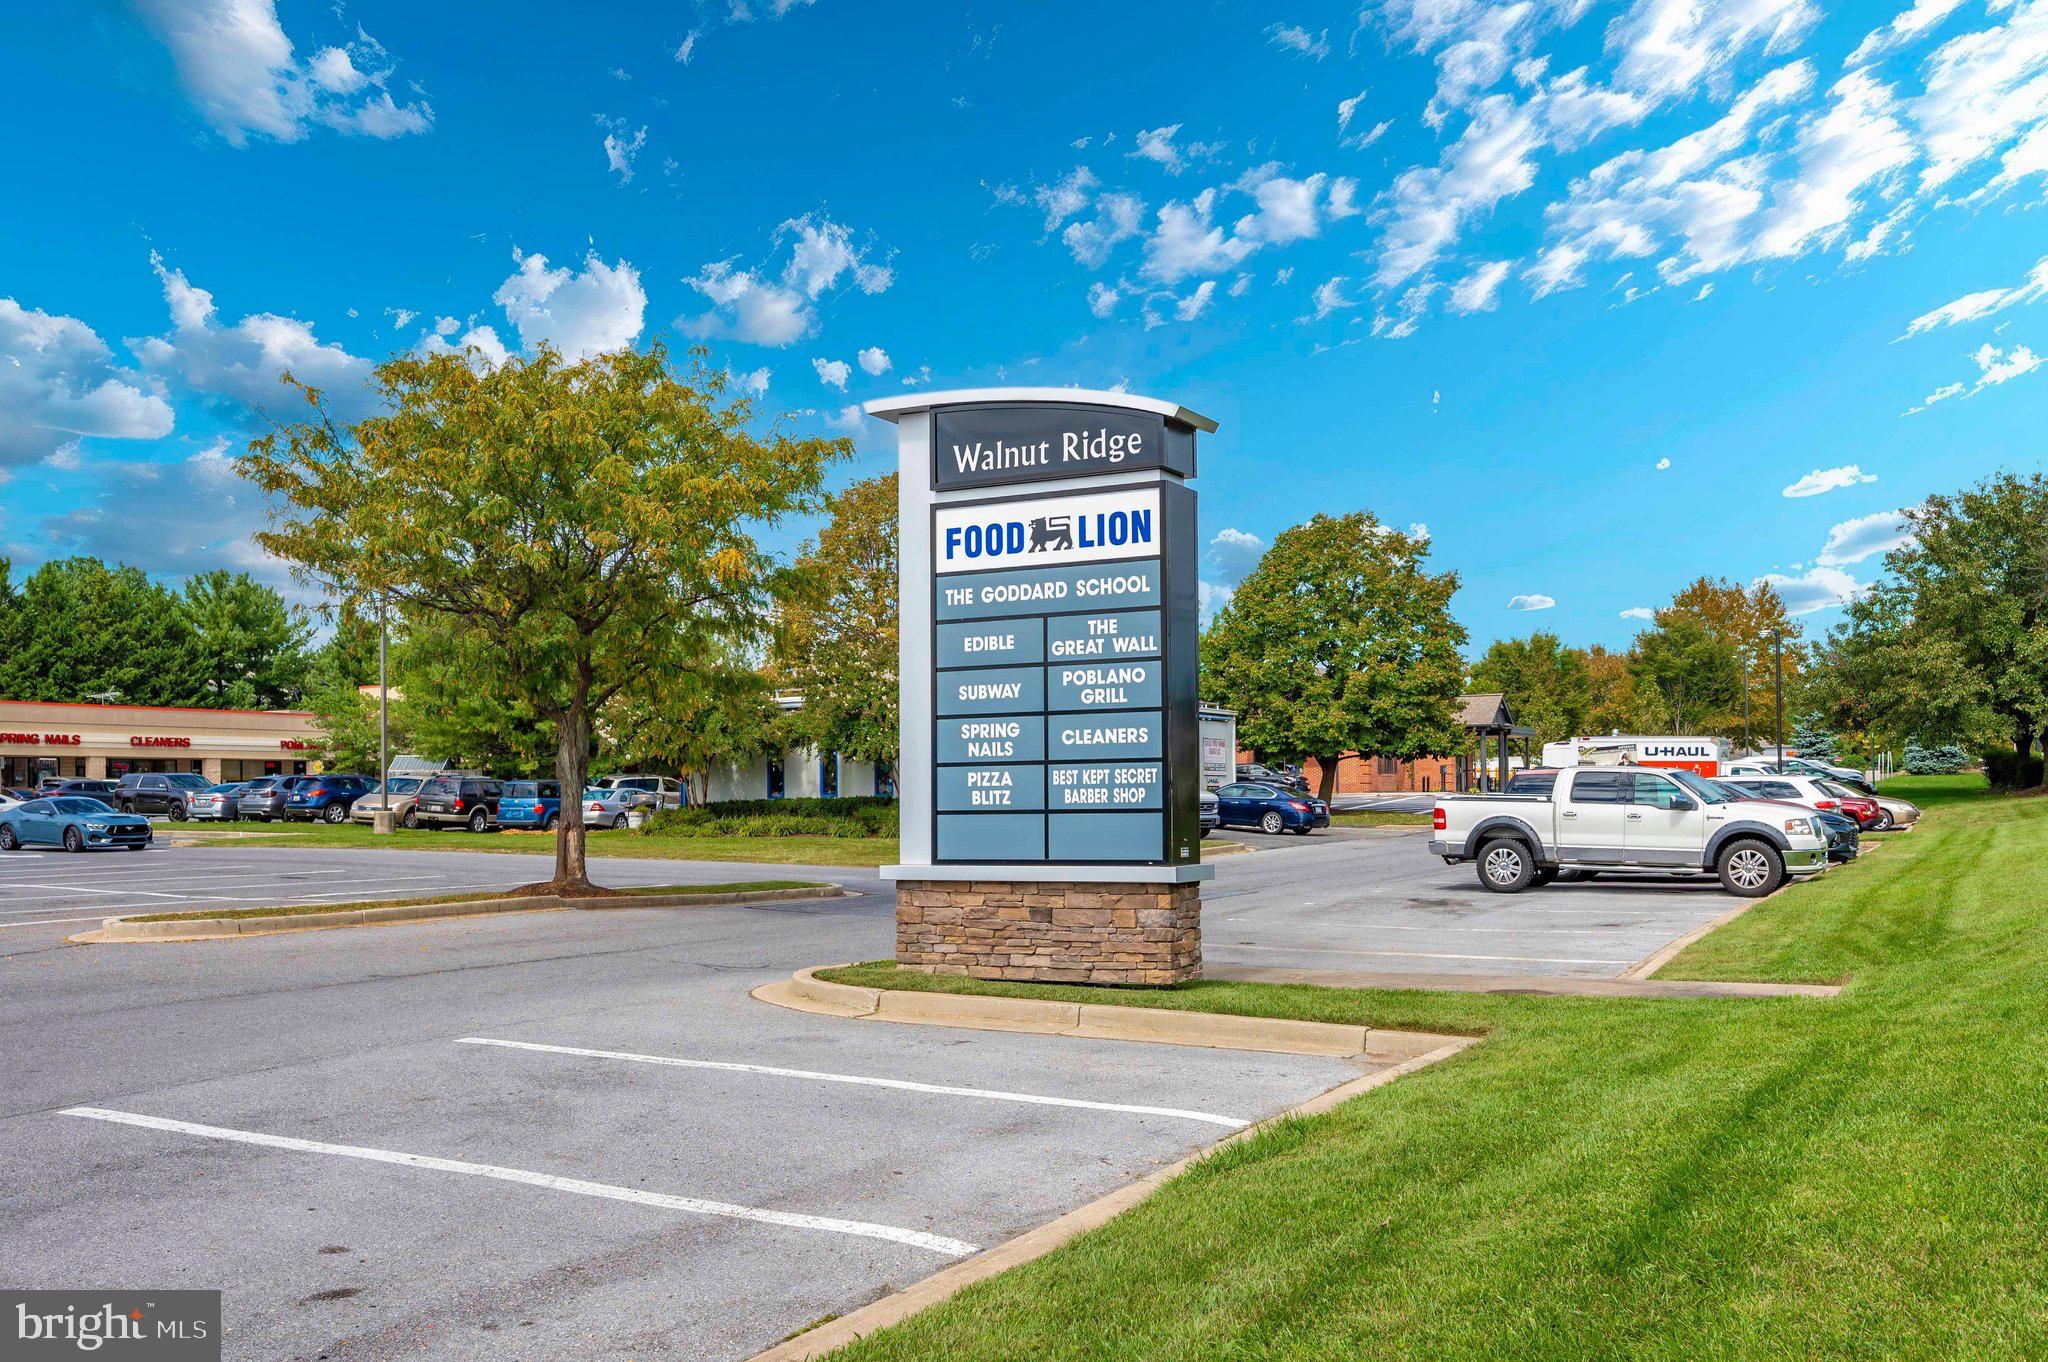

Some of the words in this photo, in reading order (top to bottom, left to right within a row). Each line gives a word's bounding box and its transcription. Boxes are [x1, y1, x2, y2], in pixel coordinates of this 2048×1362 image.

[952, 440, 1050, 473] Walnut
[1062, 428, 1142, 463] Ridge
[946, 521, 1025, 560] FOOD
[1078, 509, 1151, 548] LION
[945, 588, 974, 606] THE
[980, 580, 1068, 604] GODDARD
[1075, 574, 1151, 597] SCHOOL
[1087, 618, 1118, 635] THE
[963, 634, 1015, 652] EDIBLE
[1051, 638, 1105, 657] GREAT
[1112, 635, 1158, 653] WALL
[1062, 667, 1146, 687] POBLANO
[958, 682, 1022, 701] SUBWAY
[1080, 687, 1128, 705] GRILL
[960, 721, 1020, 739] SPRING
[1061, 726, 1149, 746] CLEANERS
[45, 734, 81, 746] NAILS
[130, 735, 191, 748] CLEANERS
[967, 740, 1013, 758] NAILS
[1644, 746, 1710, 757] U-HAUL
[967, 771, 1013, 787] PIZZA
[1052, 769, 1078, 786] BEST
[1082, 768, 1110, 785] KEPT
[1114, 767, 1158, 785] SECRET
[971, 789, 1011, 806] BLITZ
[1064, 787, 1109, 804] BARBER
[1113, 787, 1146, 804] SHOP
